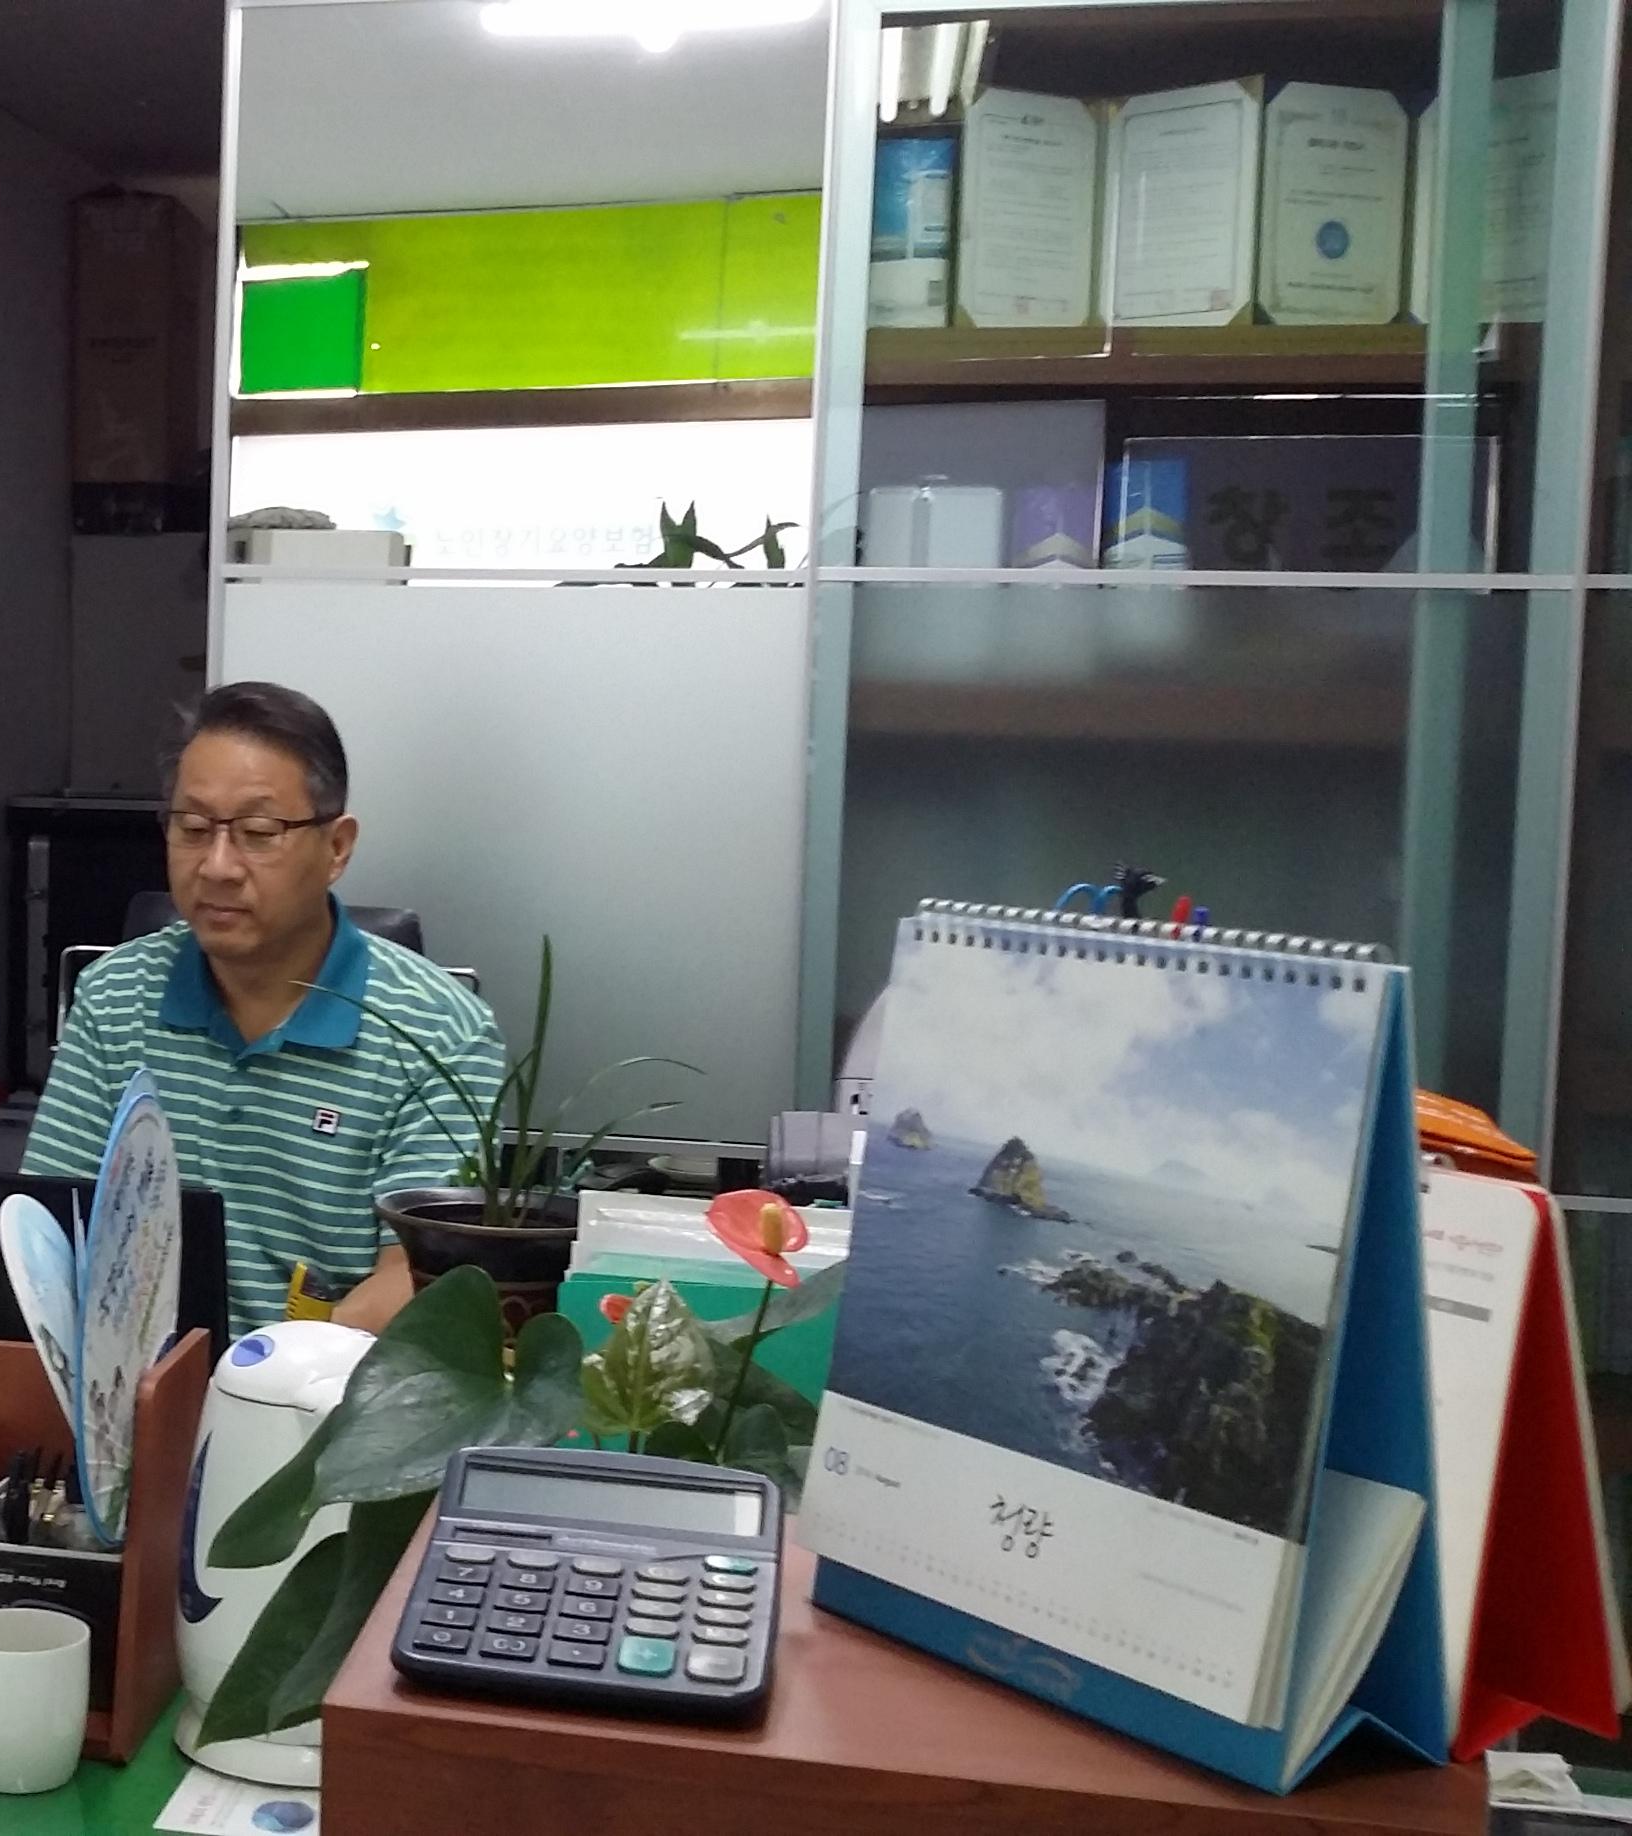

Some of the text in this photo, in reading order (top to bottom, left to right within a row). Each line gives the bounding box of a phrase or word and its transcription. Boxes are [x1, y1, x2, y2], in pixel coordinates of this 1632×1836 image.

[434, 525, 657, 558] 노인장기요양보험
[823, 1446, 850, 1476] 08
[988, 1492, 1056, 1559] 청량
[457, 1566, 603, 1591] 7 8 9
[448, 1588, 597, 1614] 4 5 6
[446, 1610, 591, 1635] 1 2 3
[432, 1631, 452, 1643] 0
